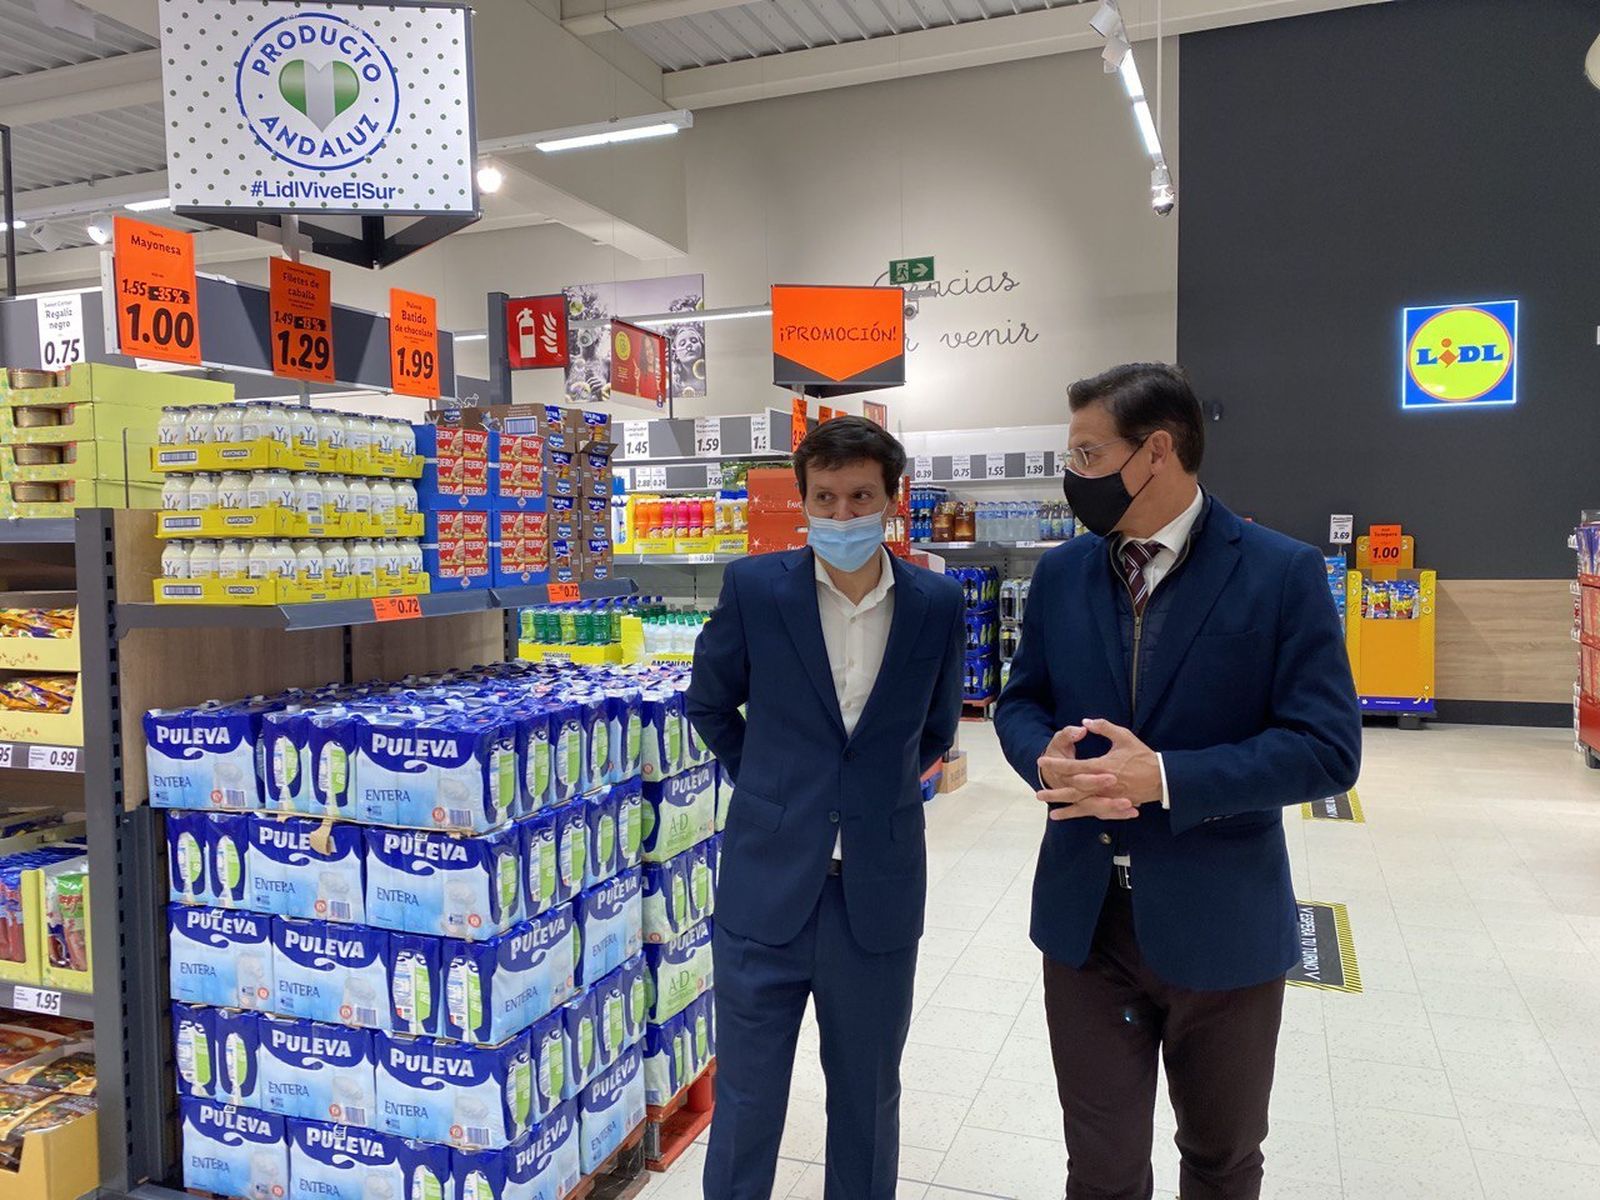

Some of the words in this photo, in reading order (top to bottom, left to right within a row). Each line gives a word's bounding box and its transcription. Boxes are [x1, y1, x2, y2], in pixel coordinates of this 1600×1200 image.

[253, 24, 382, 83] PRODUCTO
[260, 113, 380, 159] ANDALUZ
[250, 181, 397, 200] #LidlViveElSur
[130, 235, 182, 256] Mayonesa
[122, 279, 147, 297] 1.55
[49, 320, 71, 331] negro
[126, 303, 195, 349] 1.00
[274, 310, 294, 325] 1.49
[401, 310, 427, 325] Batido
[395, 323, 403, 333] de
[780, 320, 897, 342] ¡PROMOCIÓN!
[940, 319, 1039, 349] venir
[44, 338, 80, 365] 0.75
[278, 330, 330, 371] 1.29
[396, 347, 433, 380] 1.99
[626, 440, 648, 454] 1.45
[696, 437, 720, 452] 1.59
[916, 470, 932, 479] 0.39
[953, 468, 970, 477] 0.75
[988, 466, 1005, 475] 1.55
[1026, 465, 1044, 474] 1.39
[1333, 531, 1349, 540] 3.69
[1372, 546, 1399, 559] 1.00
[564, 585, 579, 598] 0.72
[398, 599, 420, 613] 0.72
[156, 724, 231, 747] PULEVA
[372, 733, 460, 759] PULEVA
[50, 750, 75, 767] 0.99
[153, 774, 192, 789] ENTERA
[671, 768, 710, 796] PULEVA
[365, 788, 411, 803] ENTERA
[384, 833, 469, 862] PULEVA
[254, 877, 295, 895] ENTERA
[597, 874, 638, 910] PULEVA
[377, 888, 419, 906] ENTERA
[187, 911, 258, 937] PULEVA
[285, 929, 365, 959] PULEVA
[510, 916, 566, 960] PULEVA
[592, 933, 617, 958] ENTERA
[668, 922, 709, 956] PULEVA
[180, 962, 216, 978] ENTERA
[279, 979, 320, 998] ENTERA
[35, 991, 60, 1011] 1.95
[504, 985, 538, 1013] ENTERA
[272, 1029, 352, 1058] PULEVA
[390, 1047, 474, 1077] PULEVA
[592, 1052, 636, 1103] PULEVA
[268, 1081, 310, 1098] ENTERA
[384, 1103, 428, 1119] ENTERA
[200, 1106, 273, 1137] PULEVA
[306, 1126, 385, 1158] PULEVA
[516, 1115, 568, 1174] PULEVA
[191, 1155, 231, 1173] ENTERA
[299, 1178, 340, 1197] ENTERA
